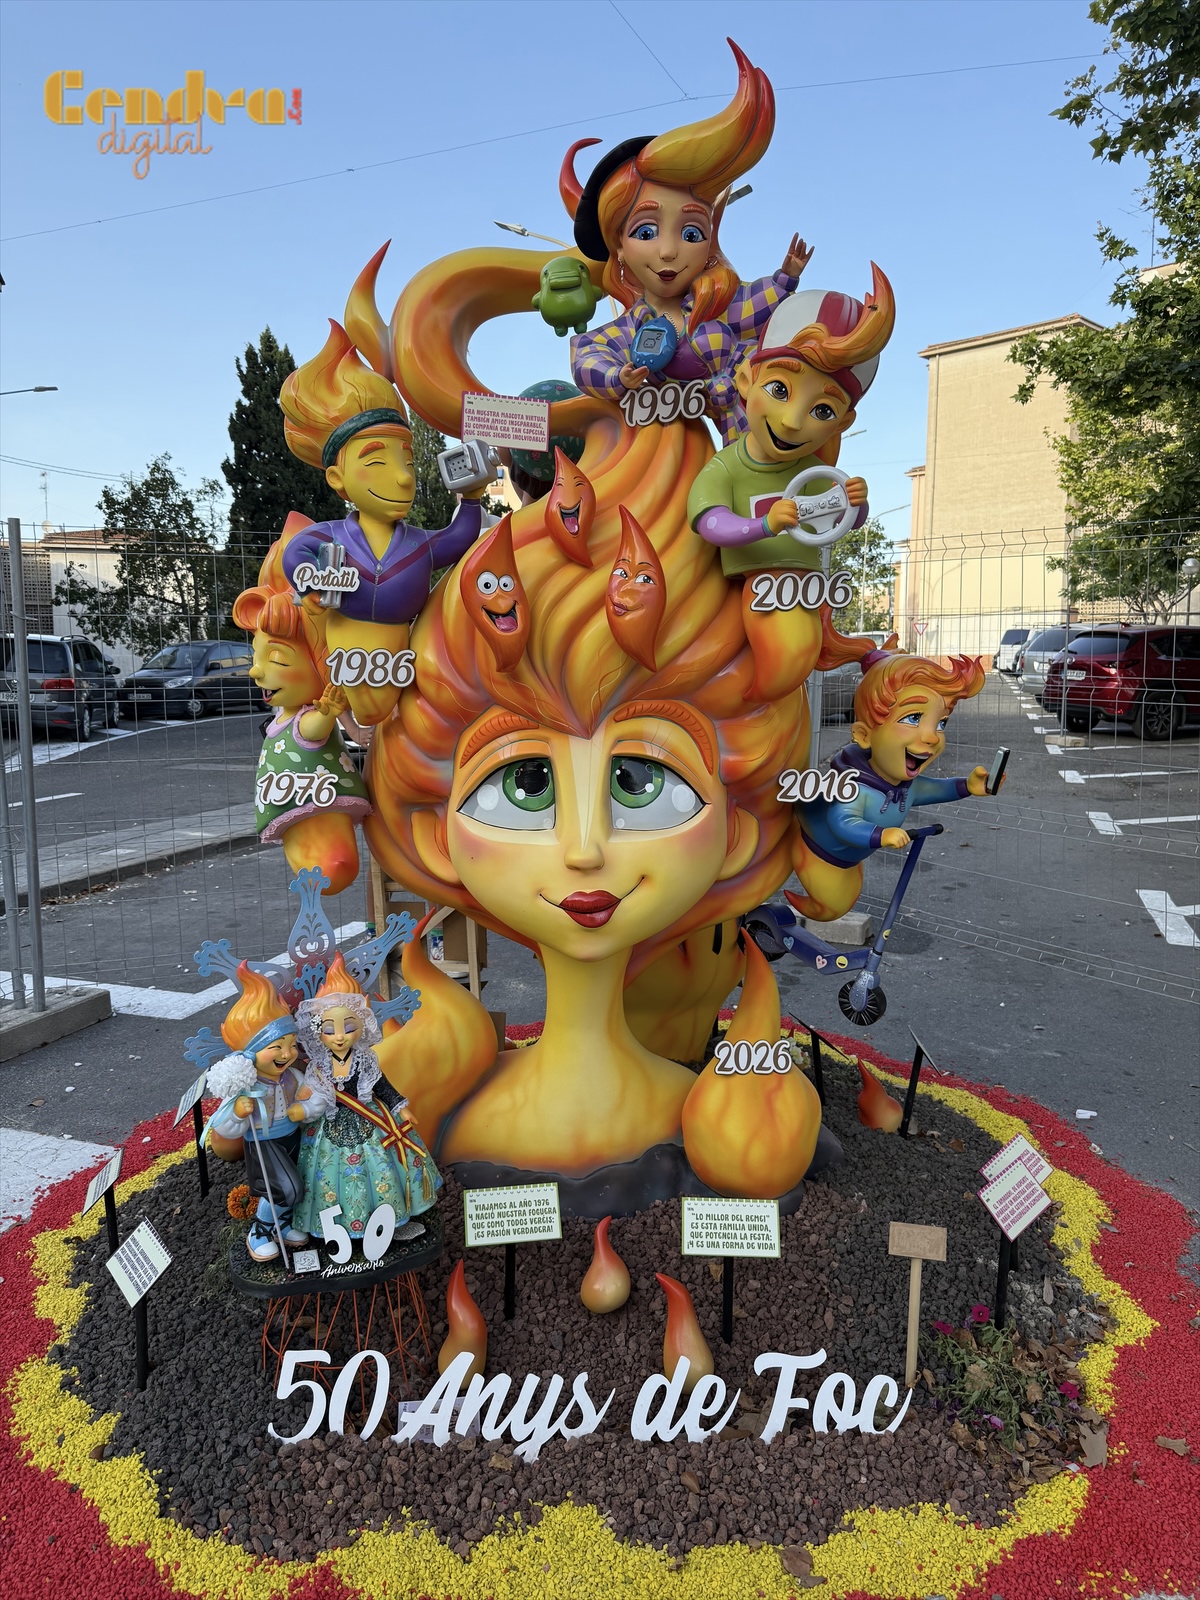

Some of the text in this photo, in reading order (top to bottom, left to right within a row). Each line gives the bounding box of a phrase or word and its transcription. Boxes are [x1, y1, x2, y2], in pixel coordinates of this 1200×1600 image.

[620, 380, 705, 425] 1996
[467, 415, 490, 423] TAMBIÉN
[476, 409, 499, 417] NUESTRA
[501, 412, 524, 420] MASCOTA
[523, 428, 545, 436] ESPECIAL
[295, 565, 358, 589] Portatil
[752, 571, 853, 609] 2006
[327, 648, 415, 687] 1986
[258, 772, 338, 806] 1976
[777, 769, 860, 802] 2016
[715, 1041, 791, 1073] 2026
[475, 1202, 507, 1211] VIAJAMOS
[519, 1199, 532, 1207] AÑO
[476, 1210, 495, 1220] NACIÓ
[497, 1209, 526, 1218] NUESTRA
[529, 1207, 557, 1216] FOGUERA
[472, 1215, 555, 1230] QUE COMO TODOS VERÉIS:
[474, 1225, 553, 1240] ¡ES PASIÓN VERDADERA!
[720, 1223, 745, 1231] FAMILIA
[748, 1224, 771, 1232] UNIDA,
[319, 1203, 396, 1264] 50
[690, 1231, 703, 1239] QUE
[705, 1232, 737, 1240] POTENCIA
[750, 1233, 772, 1241] FESTA:
[320, 1259, 385, 1279] Aniversario
[267, 1348, 914, 1464] 50 Anys de Foc
